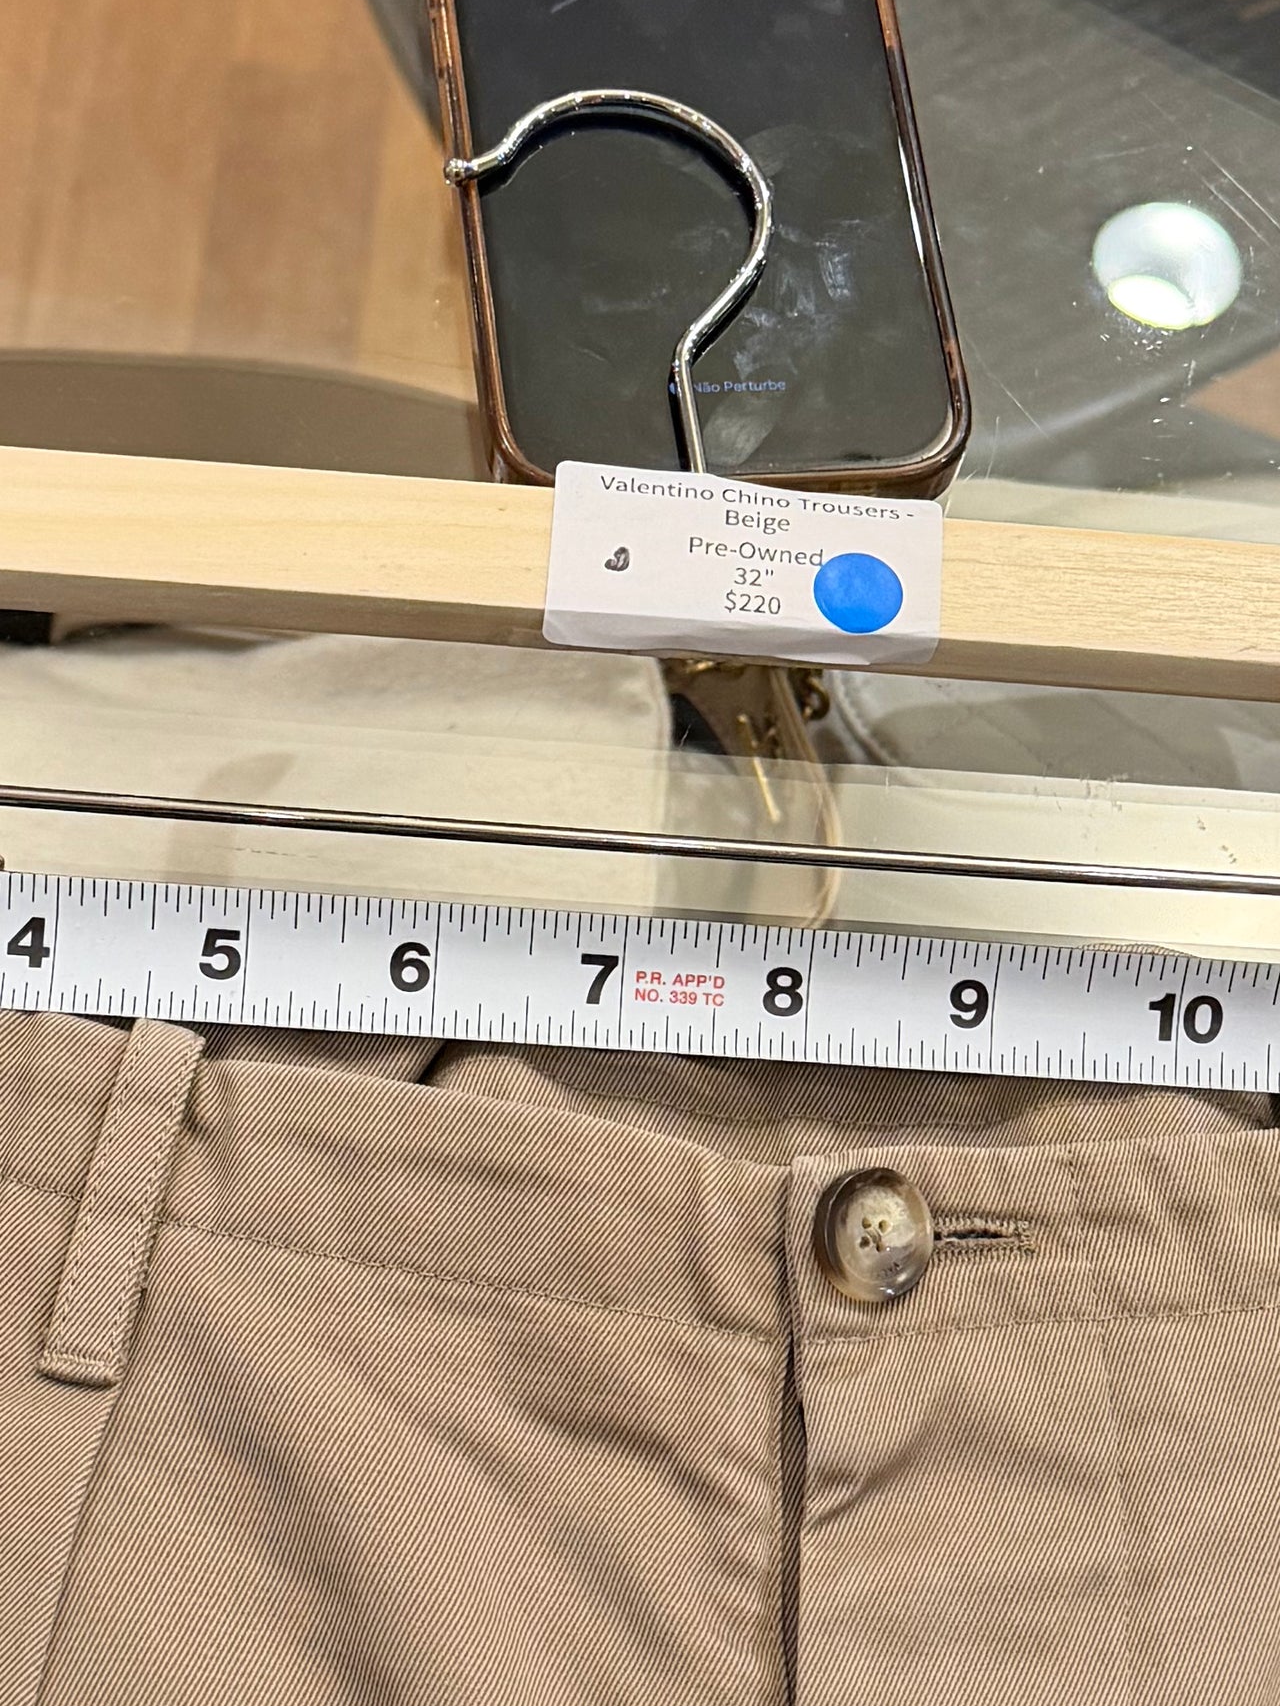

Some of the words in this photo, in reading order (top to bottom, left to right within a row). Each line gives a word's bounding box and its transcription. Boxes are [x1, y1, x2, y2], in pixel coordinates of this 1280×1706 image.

[724, 379, 786, 392] Perturbe
[601, 475, 714, 501] Valentino
[722, 487, 790, 509] Chino
[798, 497, 900, 520] Trousers
[724, 509, 790, 535] Beige
[689, 536, 824, 567] Pre-Owned
[734, 567, 774, 587] 32"
[724, 589, 781, 616] $220
[6, 917, 50, 968] 4
[200, 928, 242, 981] 5
[390, 941, 431, 993] 6
[580, 953, 619, 1005] 7
[636, 969, 666, 986] P.R.
[672, 973, 725, 990] APP'D
[634, 987, 665, 1004] NO.
[669, 989, 699, 1006] 339
[702, 992, 724, 1007] TC
[762, 967, 804, 1017] 8
[949, 979, 990, 1029] 9
[1148, 993, 1222, 1044] 10
